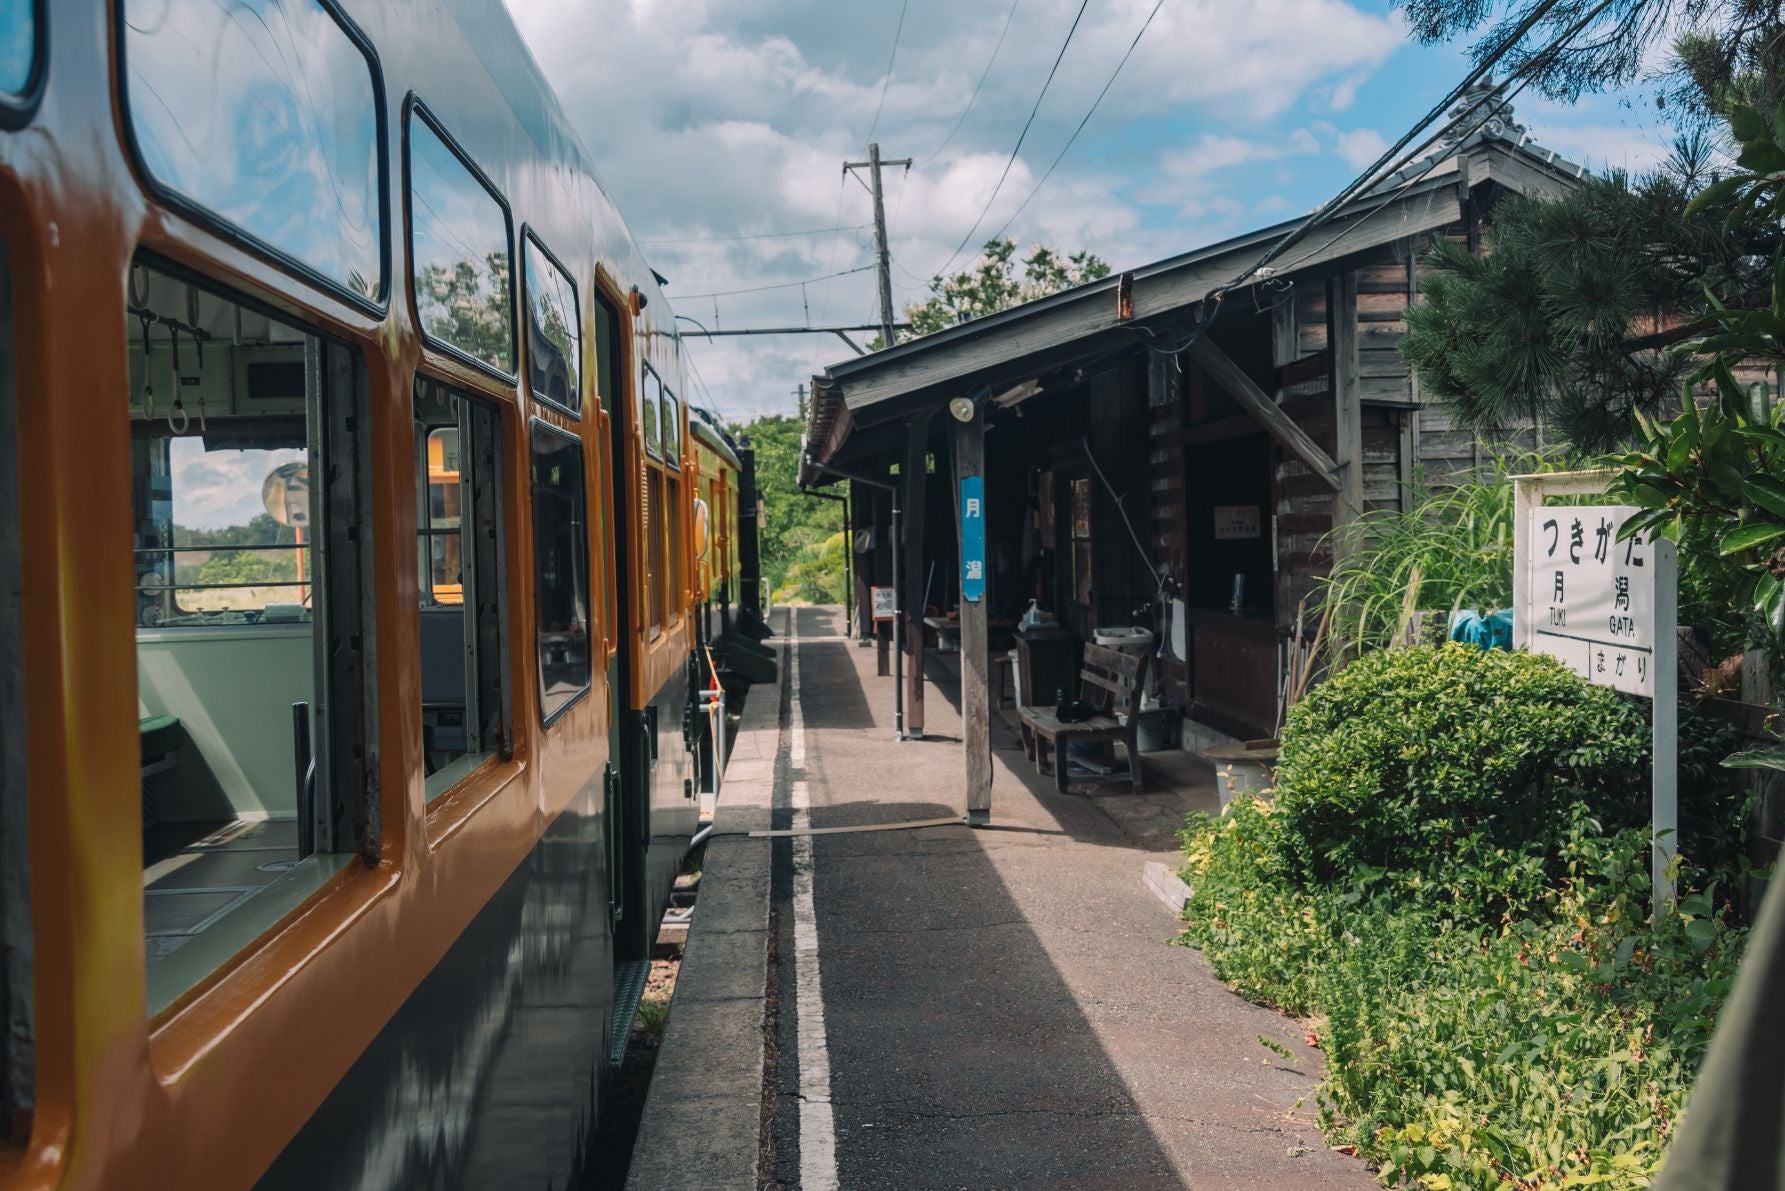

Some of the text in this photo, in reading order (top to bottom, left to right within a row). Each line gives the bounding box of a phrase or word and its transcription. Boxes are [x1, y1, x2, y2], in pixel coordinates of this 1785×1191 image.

[1549, 606, 1635, 638] TUKI GATA
[1597, 649, 1646, 683] まがり
